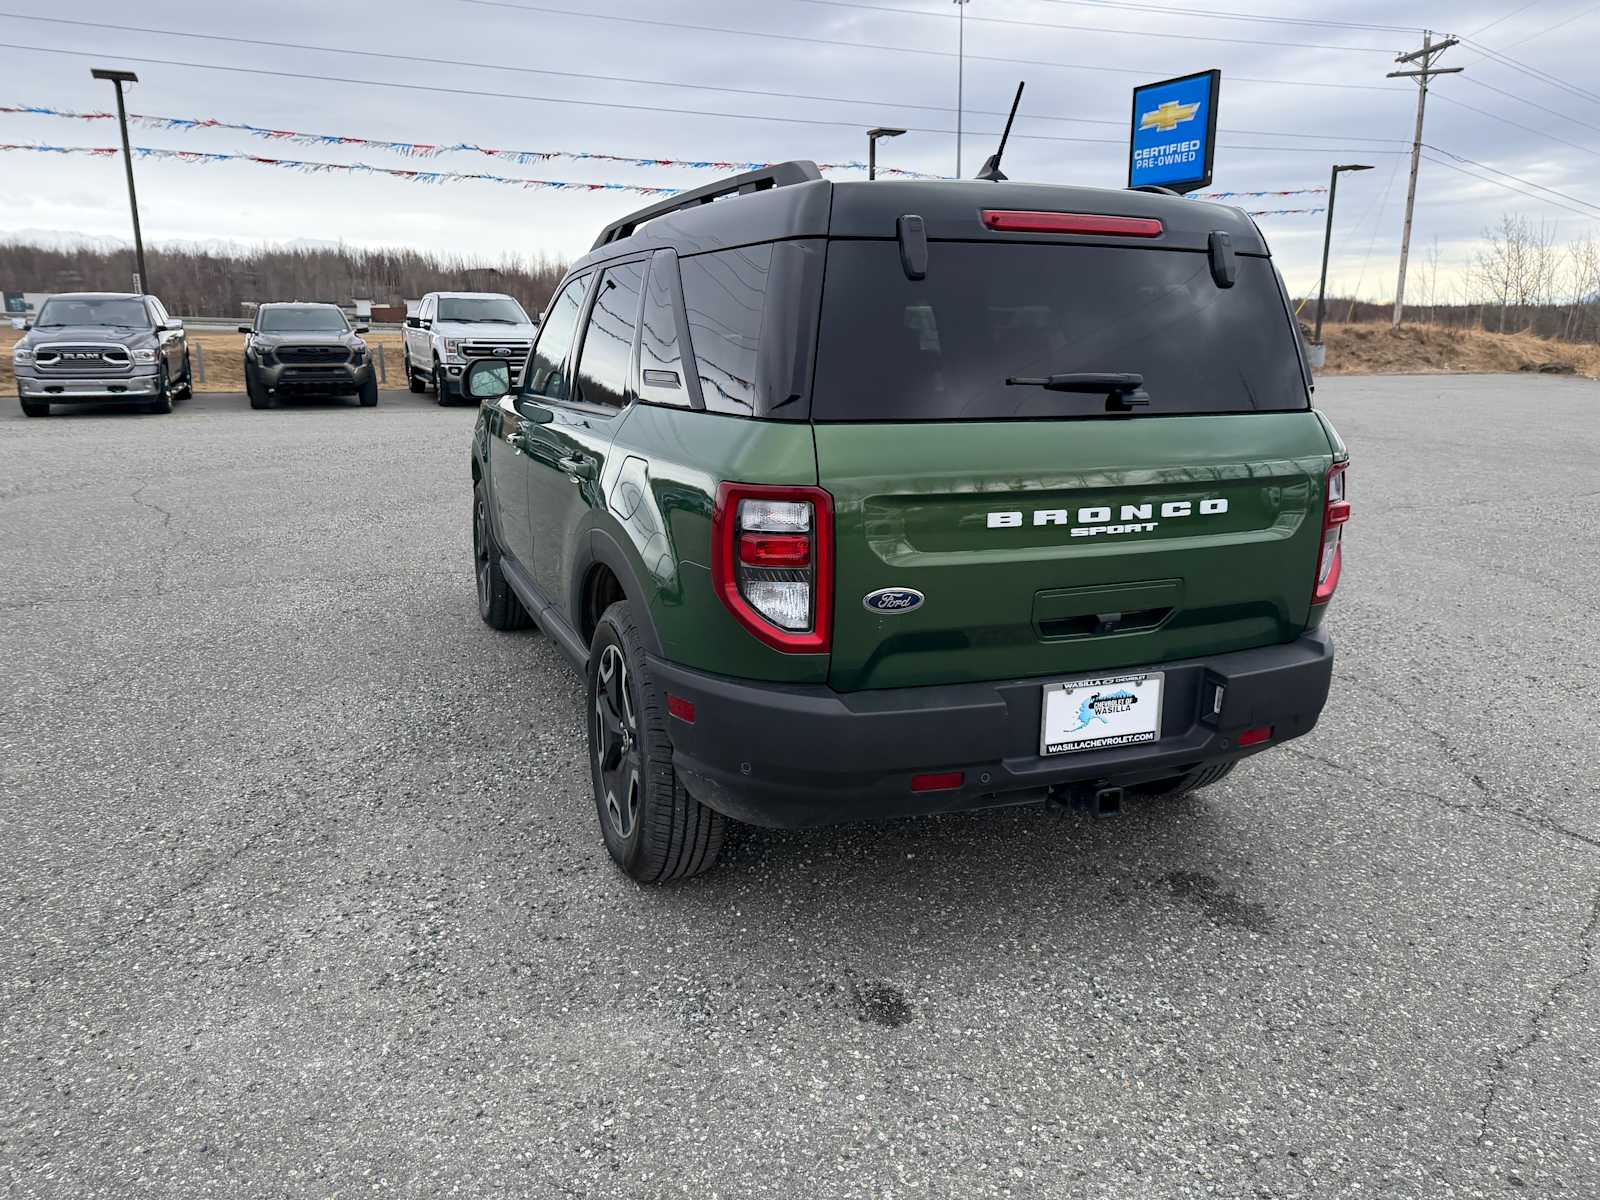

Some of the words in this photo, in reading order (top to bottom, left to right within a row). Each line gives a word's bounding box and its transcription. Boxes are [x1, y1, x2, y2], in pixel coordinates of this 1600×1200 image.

[1134, 140, 1200, 160] CERTIFIED
[1136, 152, 1196, 169] PRE-OWNED
[987, 498, 1229, 528] BRONCO
[1070, 522, 1159, 537] SPORT
[878, 593, 912, 608] Ford
[1064, 680, 1101, 689] WASILLA
[1095, 705, 1131, 715] WASILLA
[1048, 732, 1154, 753] WASILLACHEVROLET.COM
